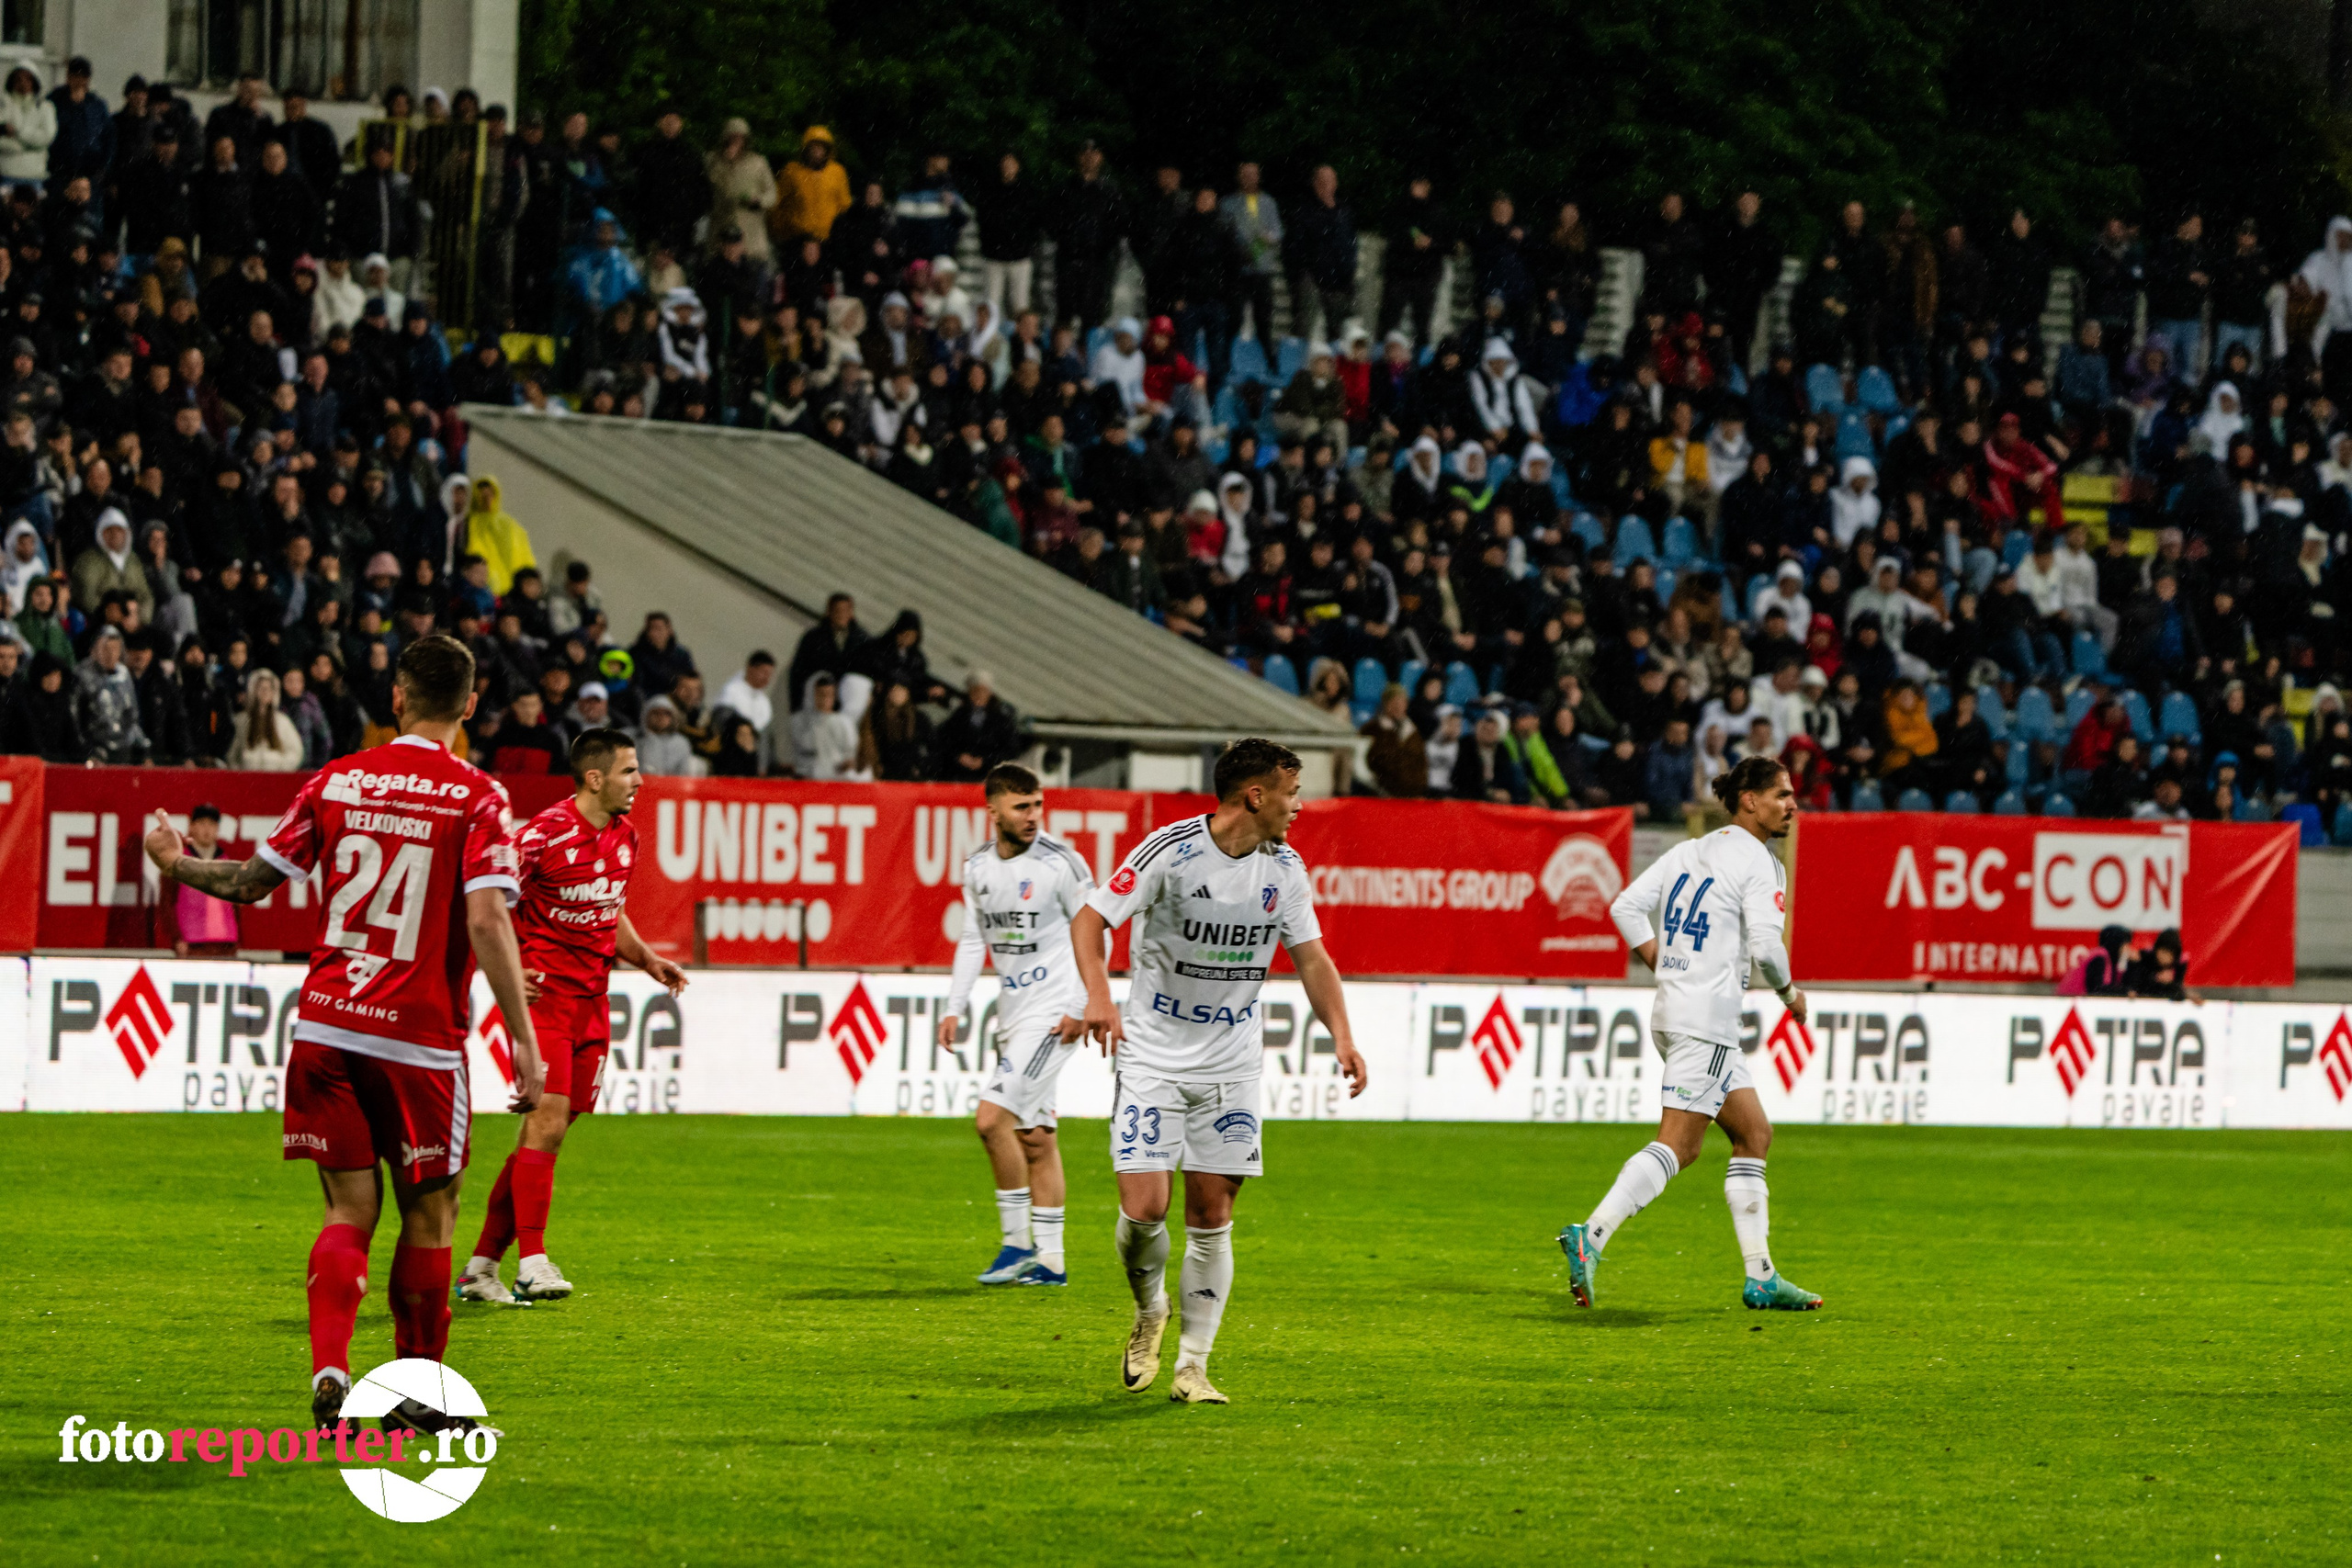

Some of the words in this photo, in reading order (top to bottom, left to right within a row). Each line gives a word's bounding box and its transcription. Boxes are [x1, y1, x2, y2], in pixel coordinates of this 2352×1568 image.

[345, 769, 470, 799] Regata.ro
[345, 809, 433, 840] VELKOVSKI
[657, 799, 876, 885] UNIBET
[915, 806, 1128, 887] UNET
[323, 834, 435, 962] 24
[1448, 868, 1535, 910] GROUP
[1183, 919, 1276, 946] UNIBET
[1664, 873, 1715, 953] 44
[1662, 955, 1690, 971] SADIKU
[334, 998, 399, 1022] GAMING
[1121, 1104, 1161, 1145] 33
